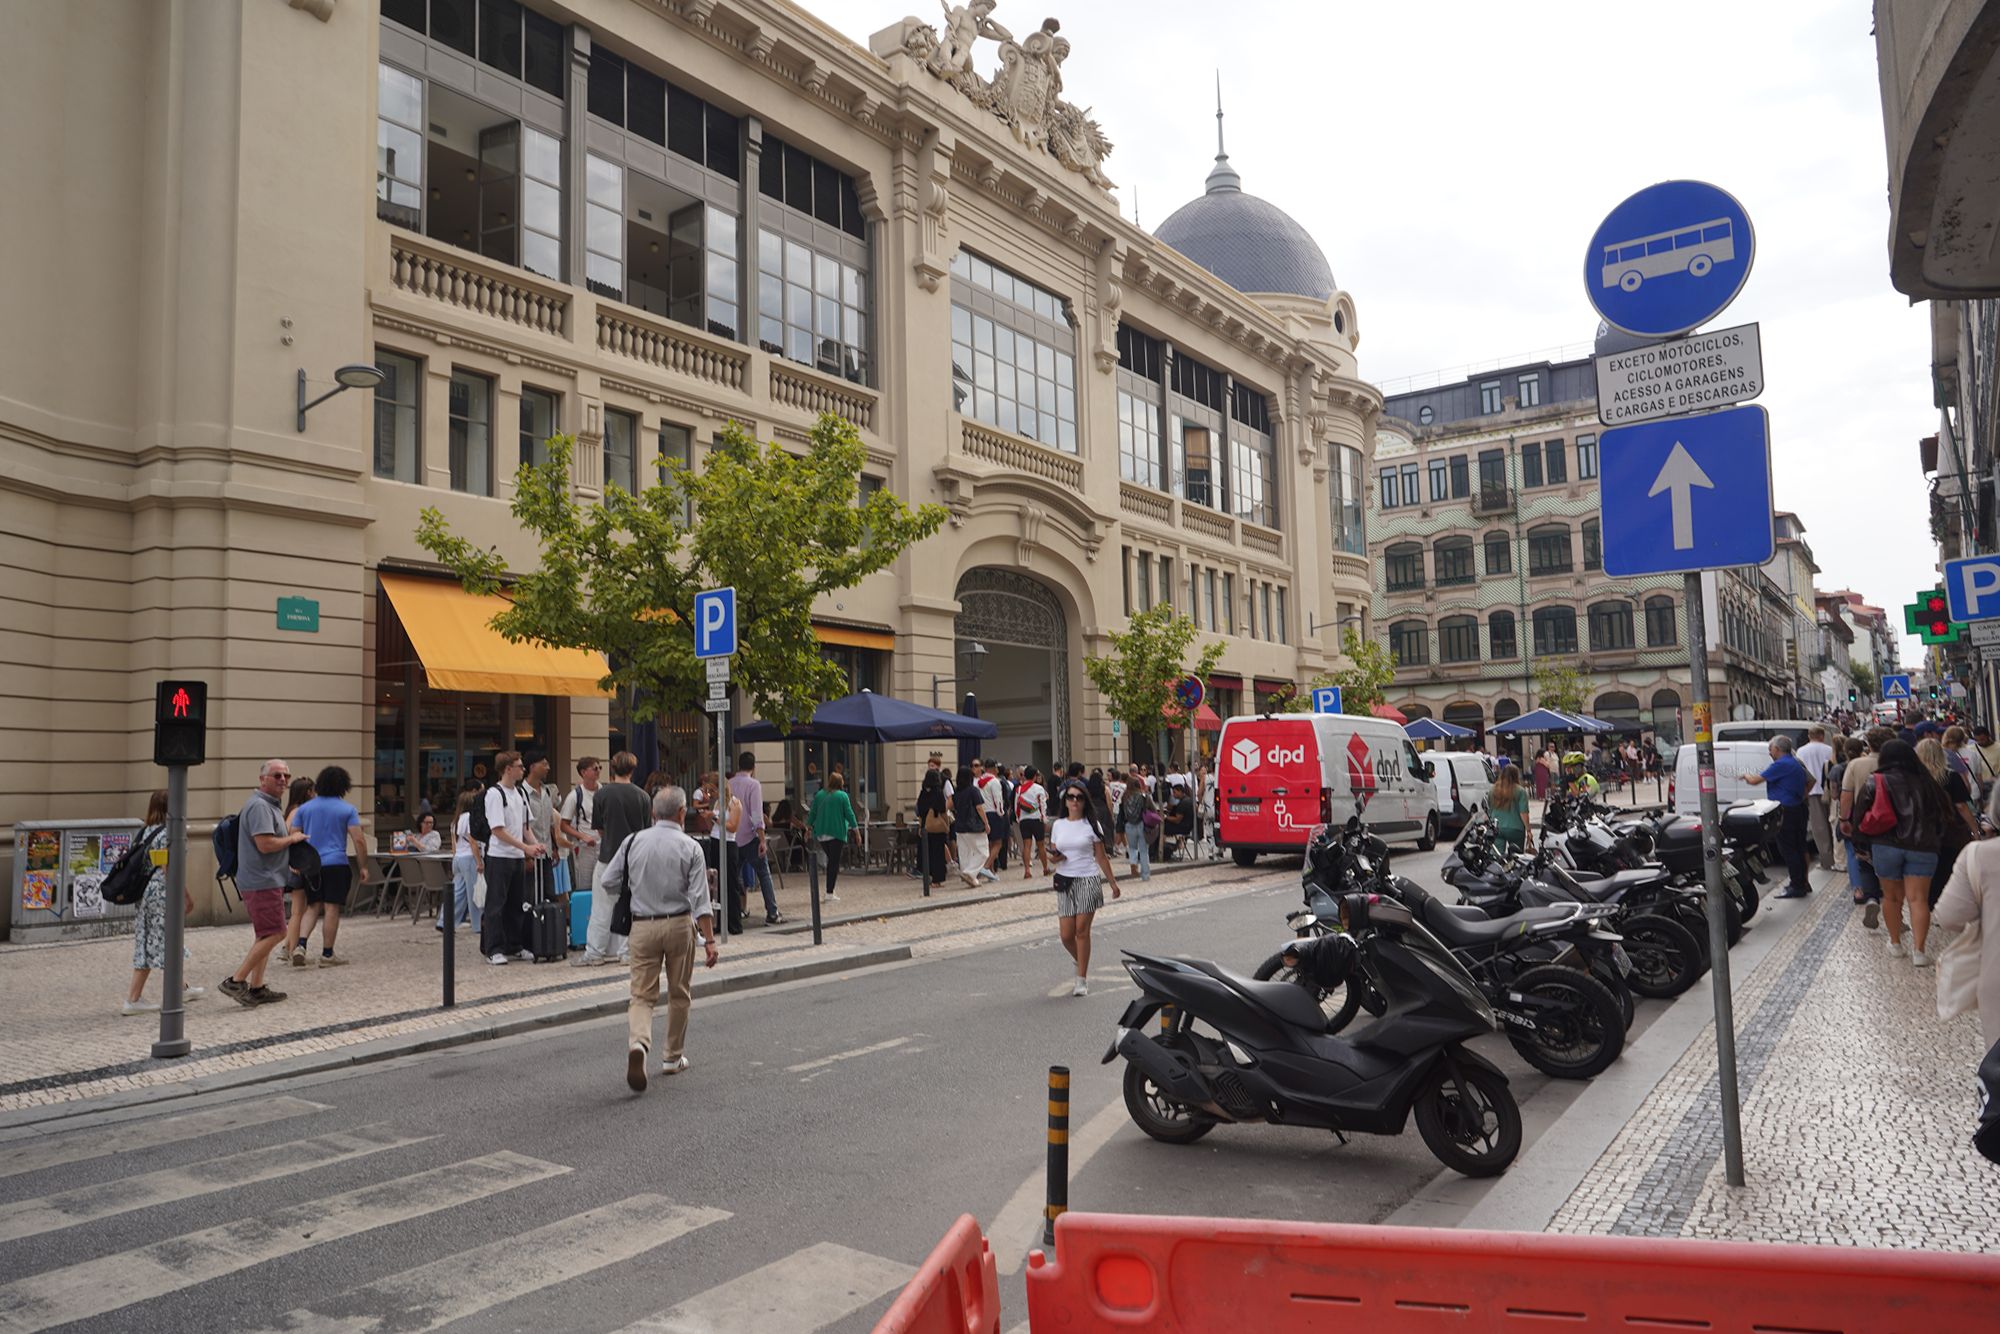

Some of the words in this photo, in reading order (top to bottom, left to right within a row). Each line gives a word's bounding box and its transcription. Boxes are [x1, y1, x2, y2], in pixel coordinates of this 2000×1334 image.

[1609, 352, 1656, 373] EXCETO
[1659, 334, 1744, 362] MOTOCICLOS,
[1627, 354, 1727, 385] CICLOMOTORES,
[1605, 408, 1614, 420] E
[1616, 398, 1665, 417] CARGAS
[1668, 396, 1676, 408] E
[1679, 381, 1757, 406] DESCARGAS
[1614, 381, 1661, 403] ACESSO
[1664, 381, 1673, 393] A
[1675, 366, 1745, 391] GARAGENS
[1962, 562, 2000, 616] P
[703, 597, 726, 651] P
[1317, 689, 1335, 713] P
[1266, 743, 1305, 768] dpd
[1377, 749, 1402, 791] dpd
